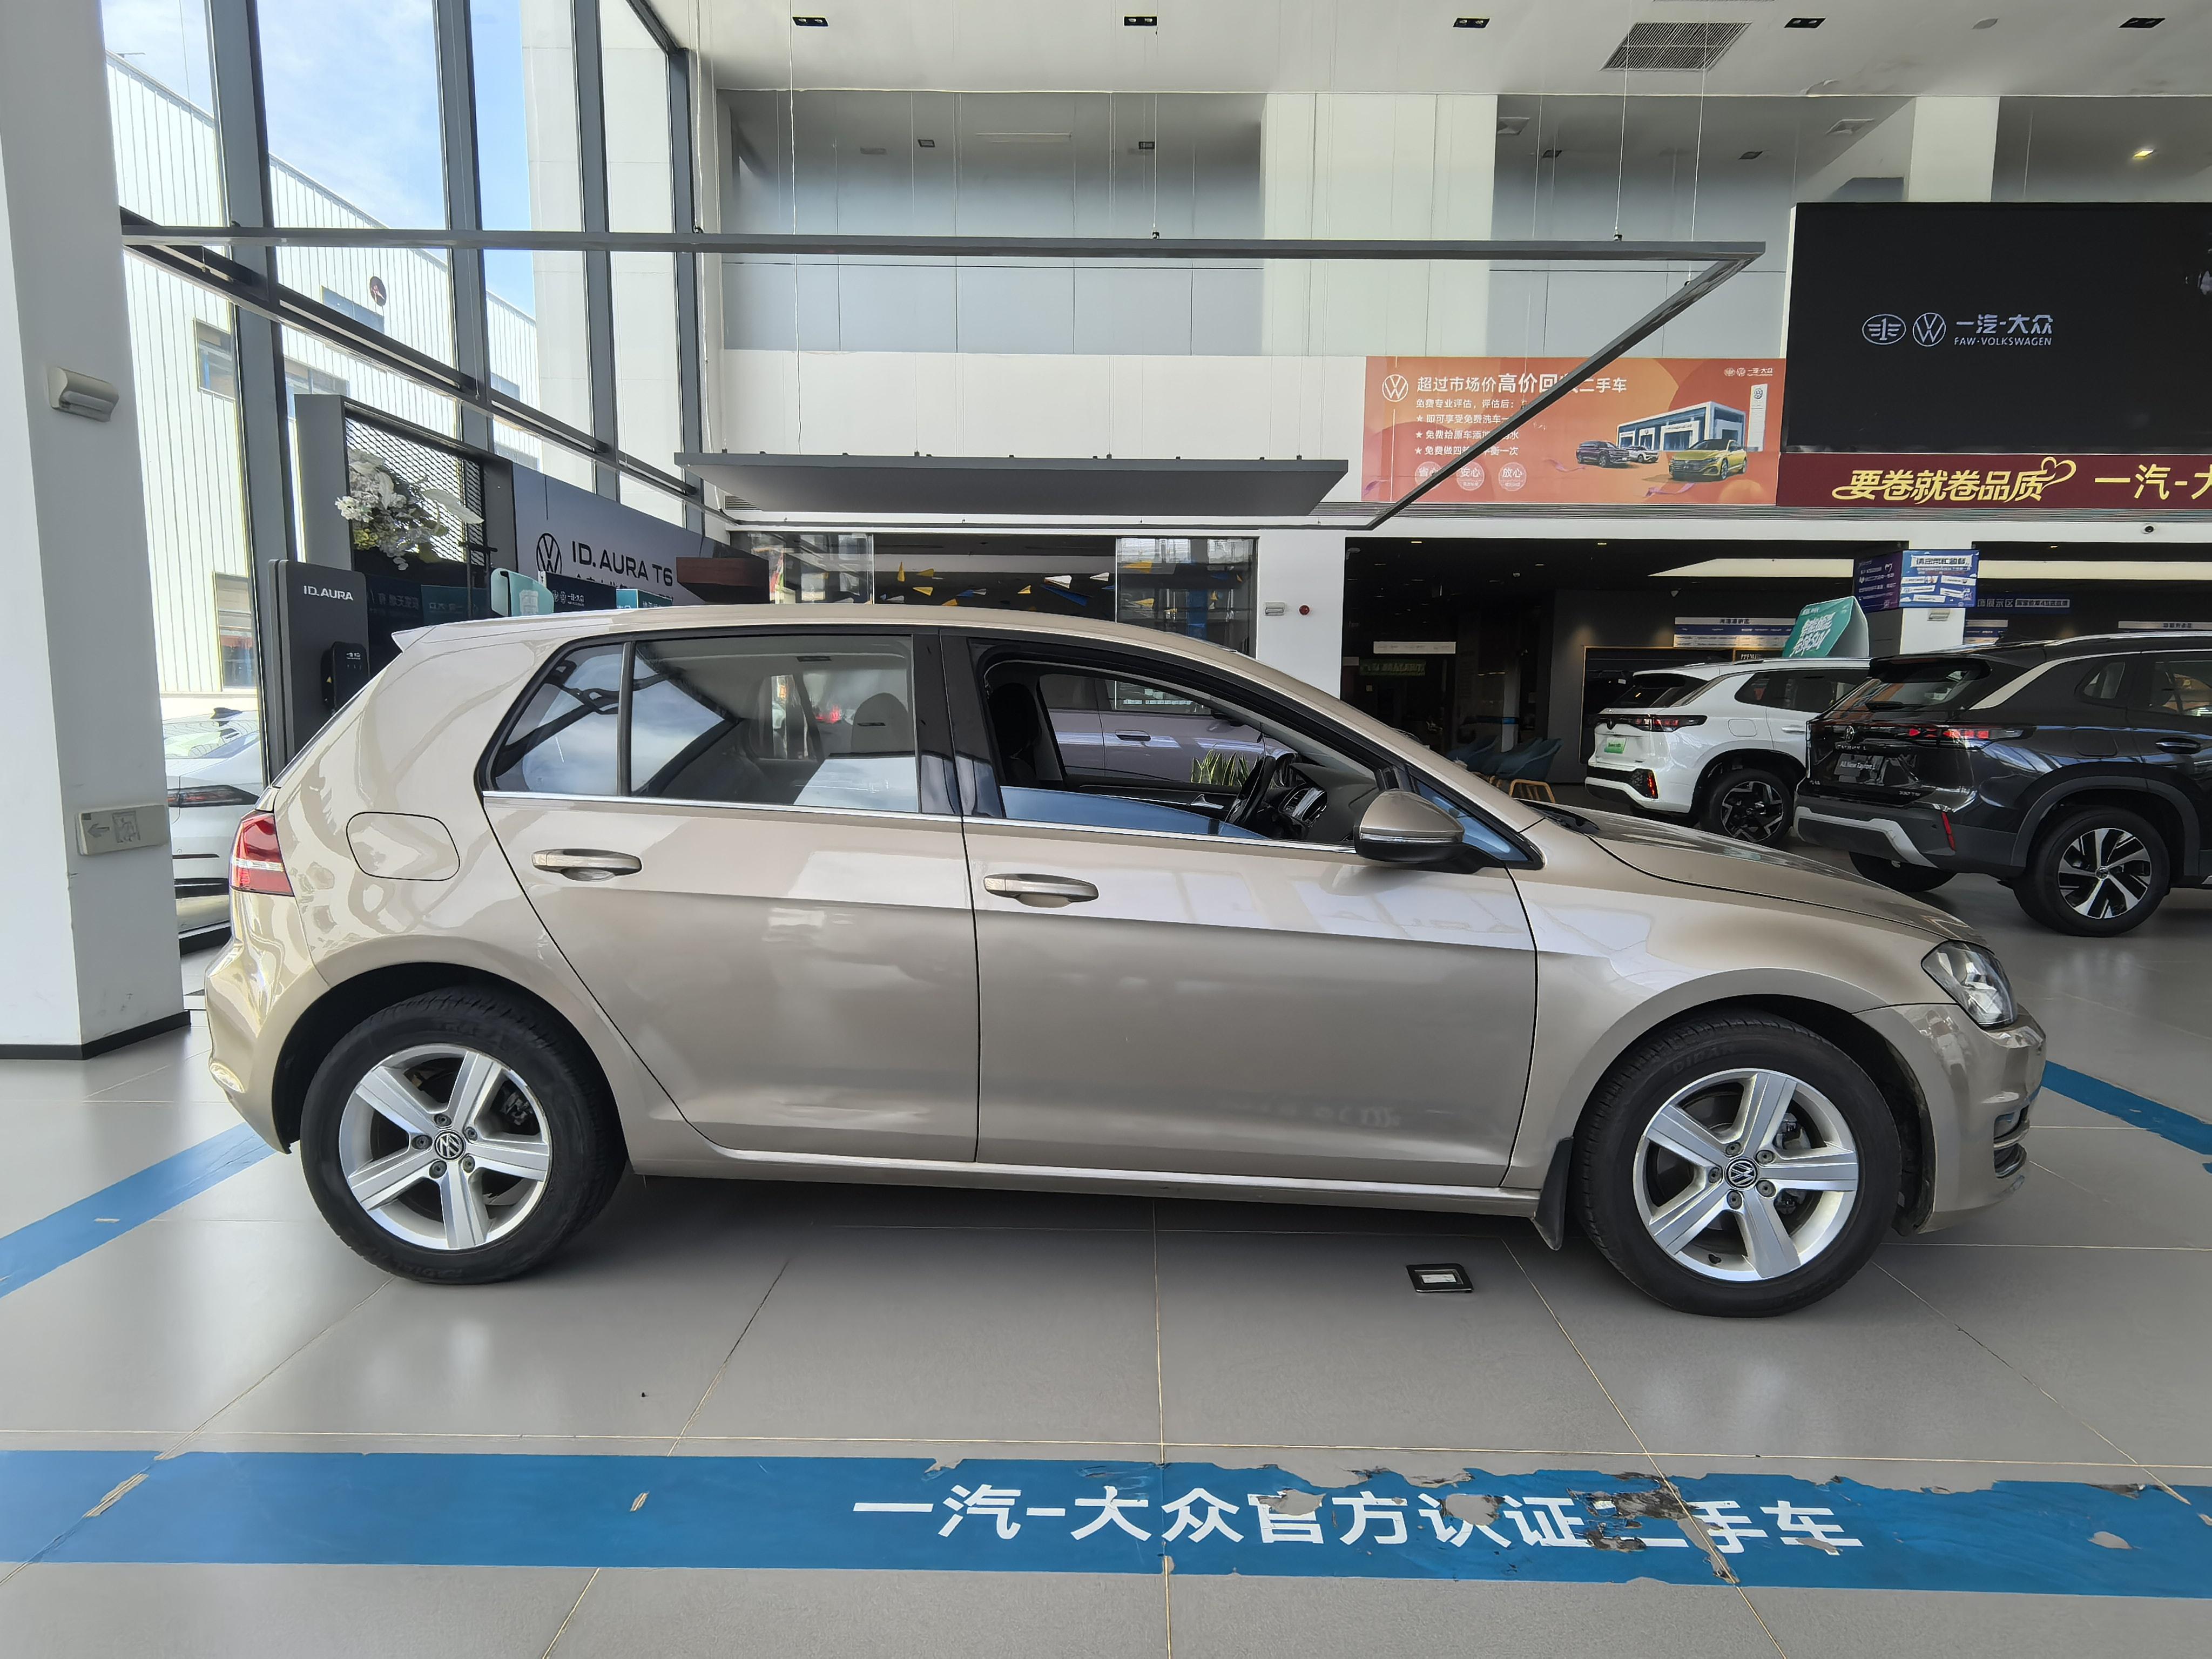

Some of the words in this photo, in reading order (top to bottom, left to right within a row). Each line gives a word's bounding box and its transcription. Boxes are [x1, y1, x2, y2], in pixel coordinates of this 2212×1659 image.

[1956, 314, 2053, 334] 一汽-大众
[1417, 373, 1627, 393] 超过市场价高价回二手车
[1832, 464, 2060, 504] 要卷就卷品质
[652, 563, 673, 587] T6
